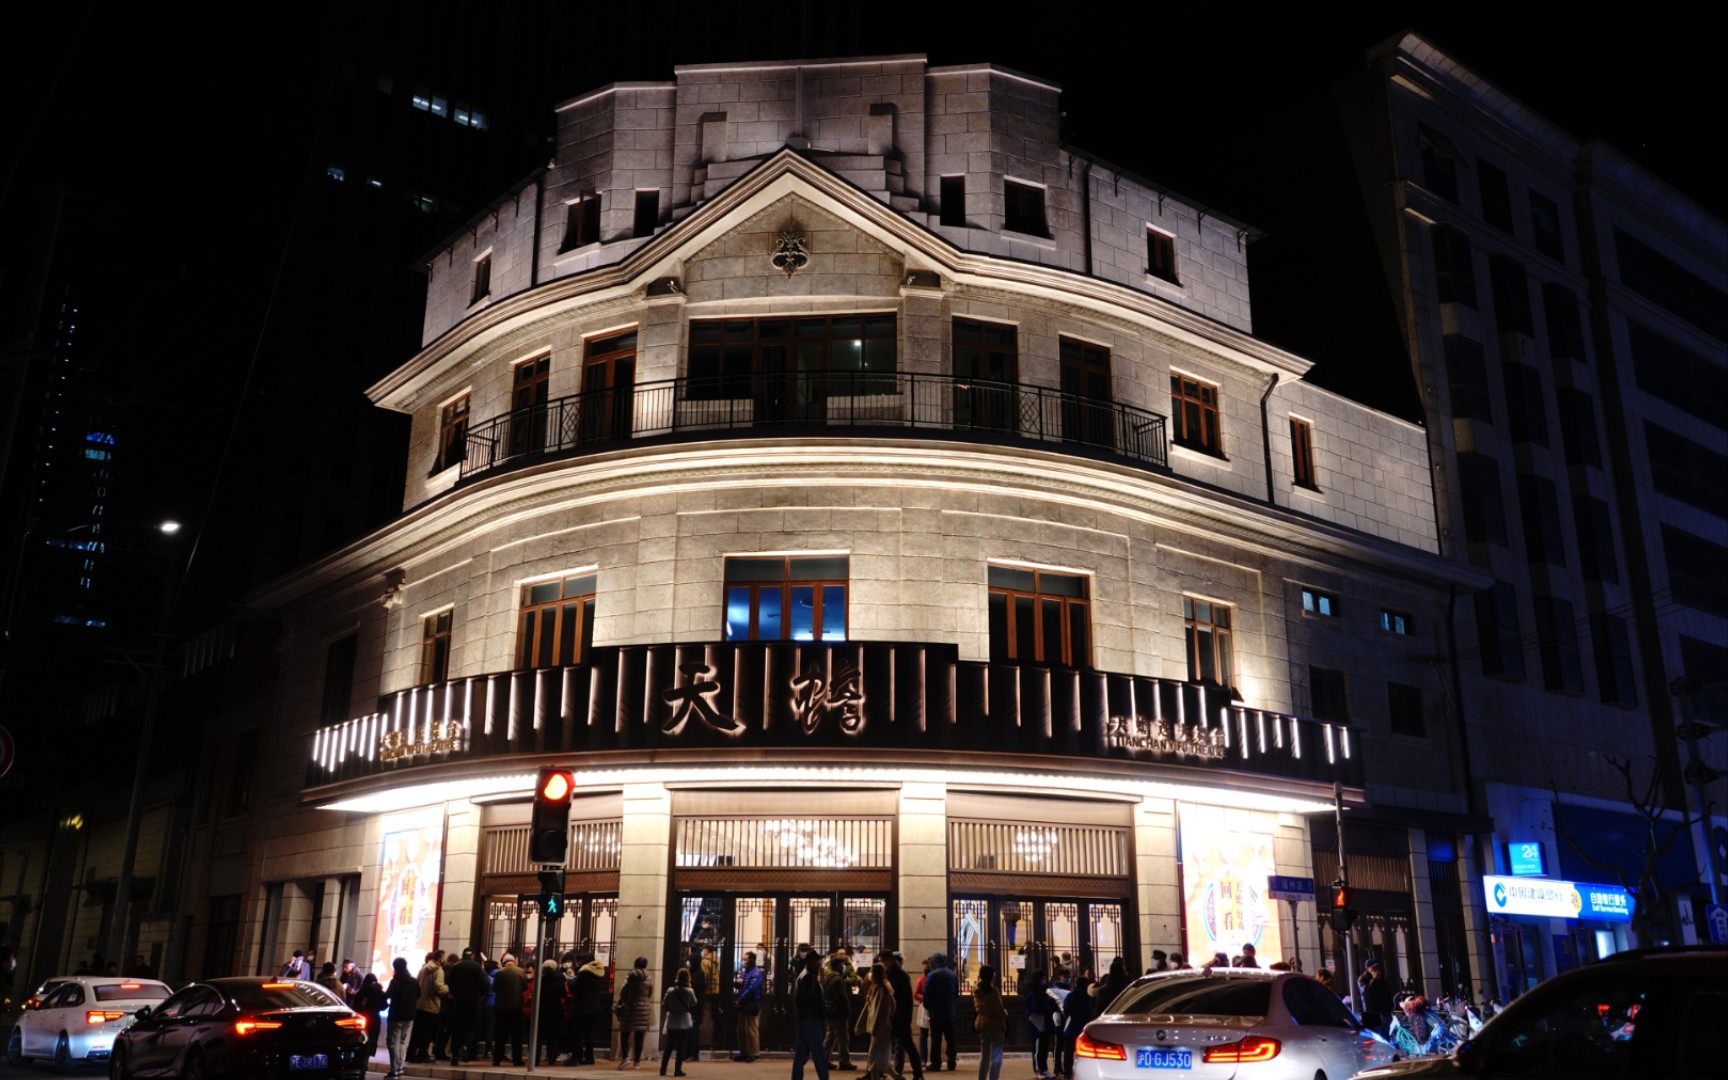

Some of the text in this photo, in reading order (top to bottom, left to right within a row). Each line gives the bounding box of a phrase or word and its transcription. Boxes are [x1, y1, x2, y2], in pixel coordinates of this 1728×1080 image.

[1114, 735, 1166, 751] TIANCHAN
[1521, 844, 1538, 858] 24
[1509, 886, 1563, 902] 中国建设银行
